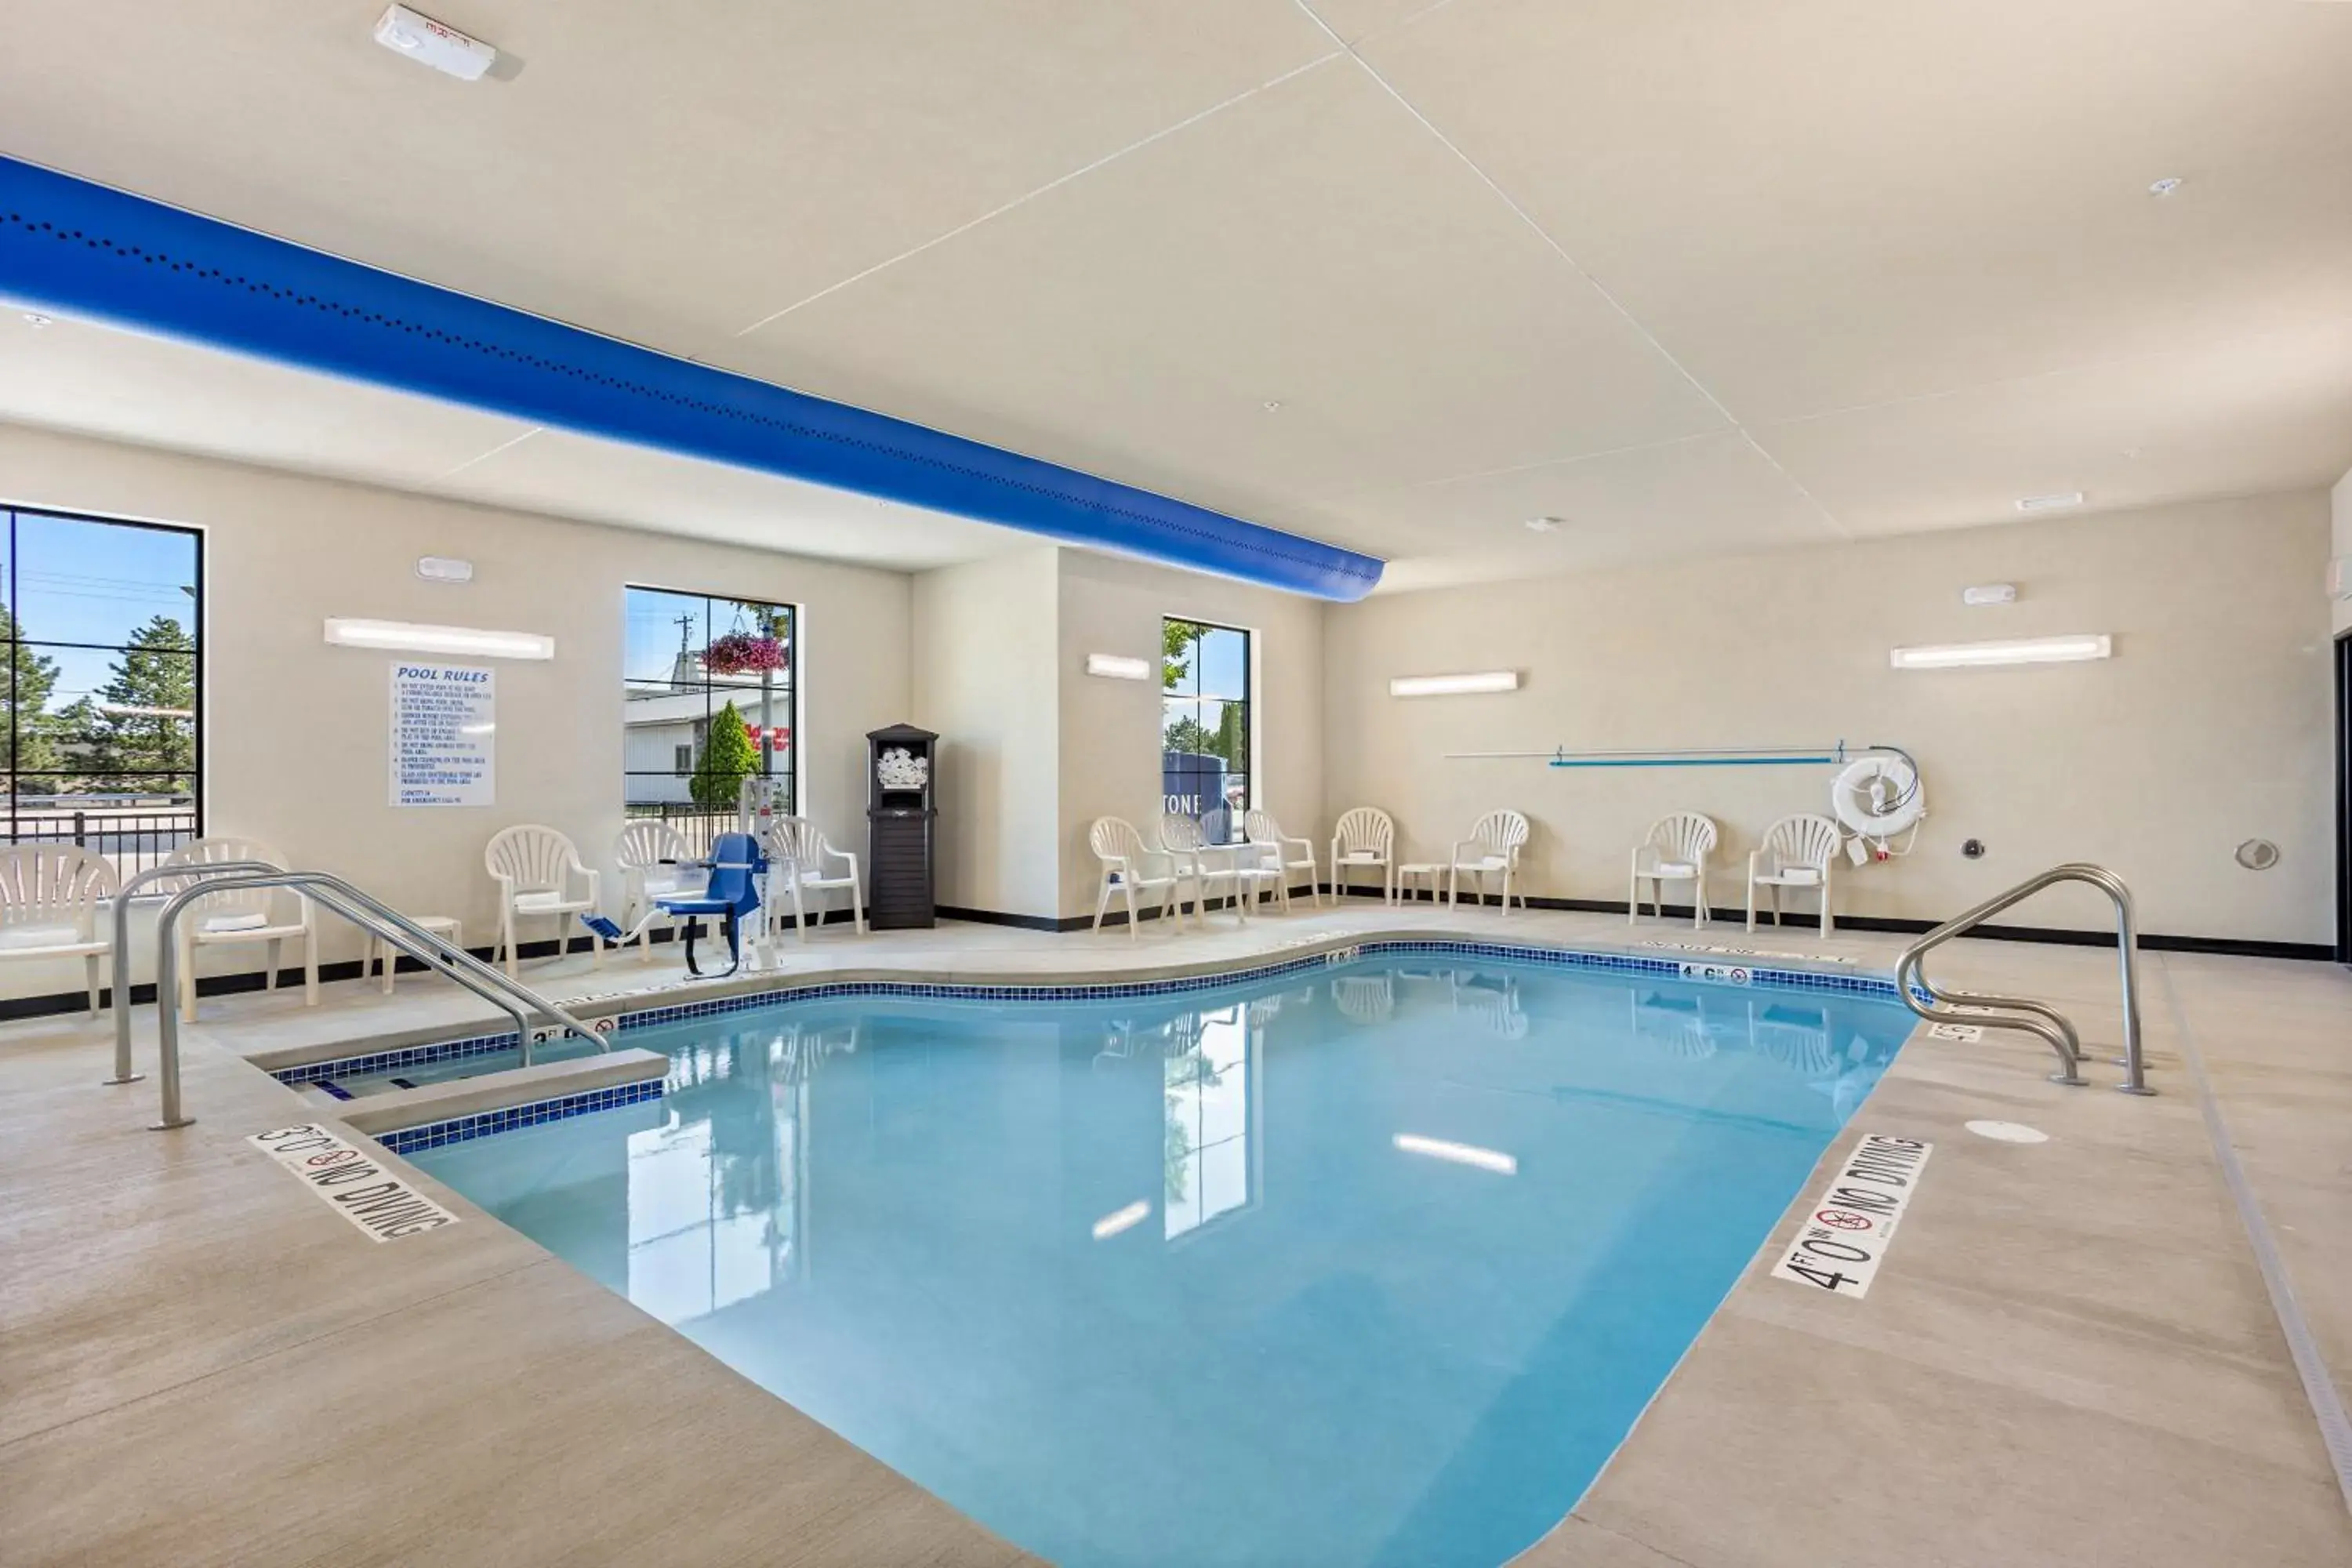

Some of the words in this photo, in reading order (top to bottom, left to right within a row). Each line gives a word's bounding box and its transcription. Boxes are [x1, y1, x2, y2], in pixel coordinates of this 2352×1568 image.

[397, 667, 437, 680] POOL
[444, 670, 489, 682] RULES
[306, 1160, 379, 1186] NO
[1846, 1136, 1925, 1188] DIVING
[332, 1181, 449, 1240] DIVING
[1828, 1188, 1900, 1217] NO
